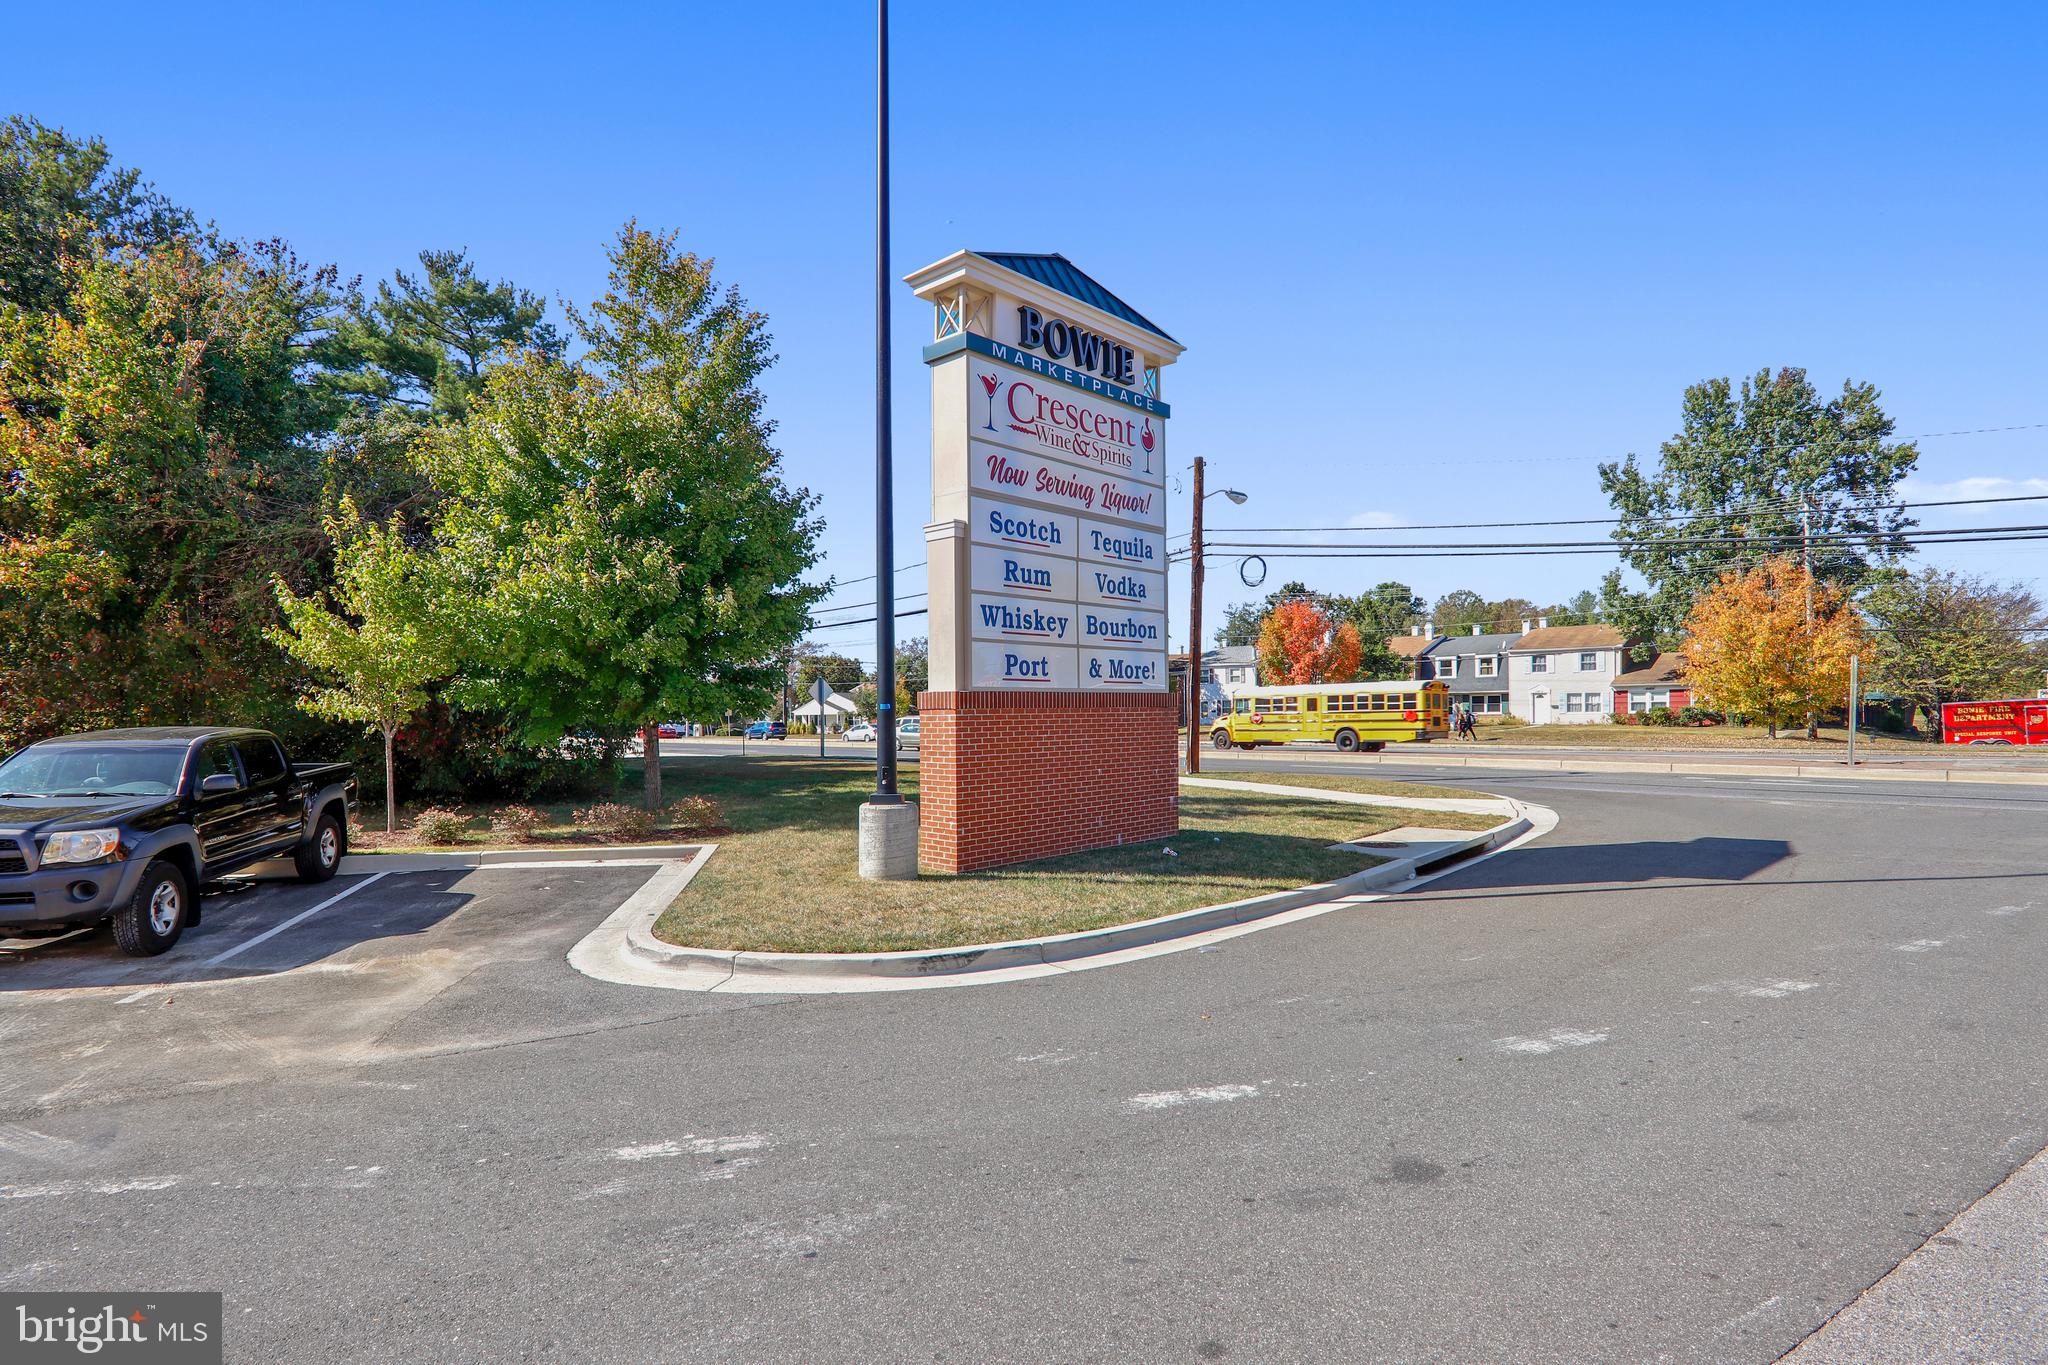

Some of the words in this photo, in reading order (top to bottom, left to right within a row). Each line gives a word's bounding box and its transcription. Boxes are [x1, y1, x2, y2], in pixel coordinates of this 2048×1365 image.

[1017, 305, 1136, 386] BOWIE
[992, 343, 1154, 411] MARKETPLACE
[1007, 382, 1136, 447] Crescent
[1035, 423, 1072, 452] Wine
[1072, 432, 1091, 459] &
[1092, 441, 1133, 469] Spirits
[986, 454, 1029, 486] Now
[1035, 467, 1096, 509] Serving
[1101, 482, 1153, 515] Liquor!
[989, 510, 1062, 544] Scotch
[1091, 530, 1154, 560] Tequila
[1003, 559, 1052, 587] Rum
[1095, 572, 1147, 598] Vodka
[980, 604, 1069, 638] Whiskey
[1086, 615, 1158, 640] Bourbon
[1004, 654, 1049, 677] Port
[1089, 658, 1103, 678] &
[1108, 659, 1156, 680] More!
[1953, 713, 2015, 722] DEPARTMENT
[1957, 706, 1985, 714] BOWIE
